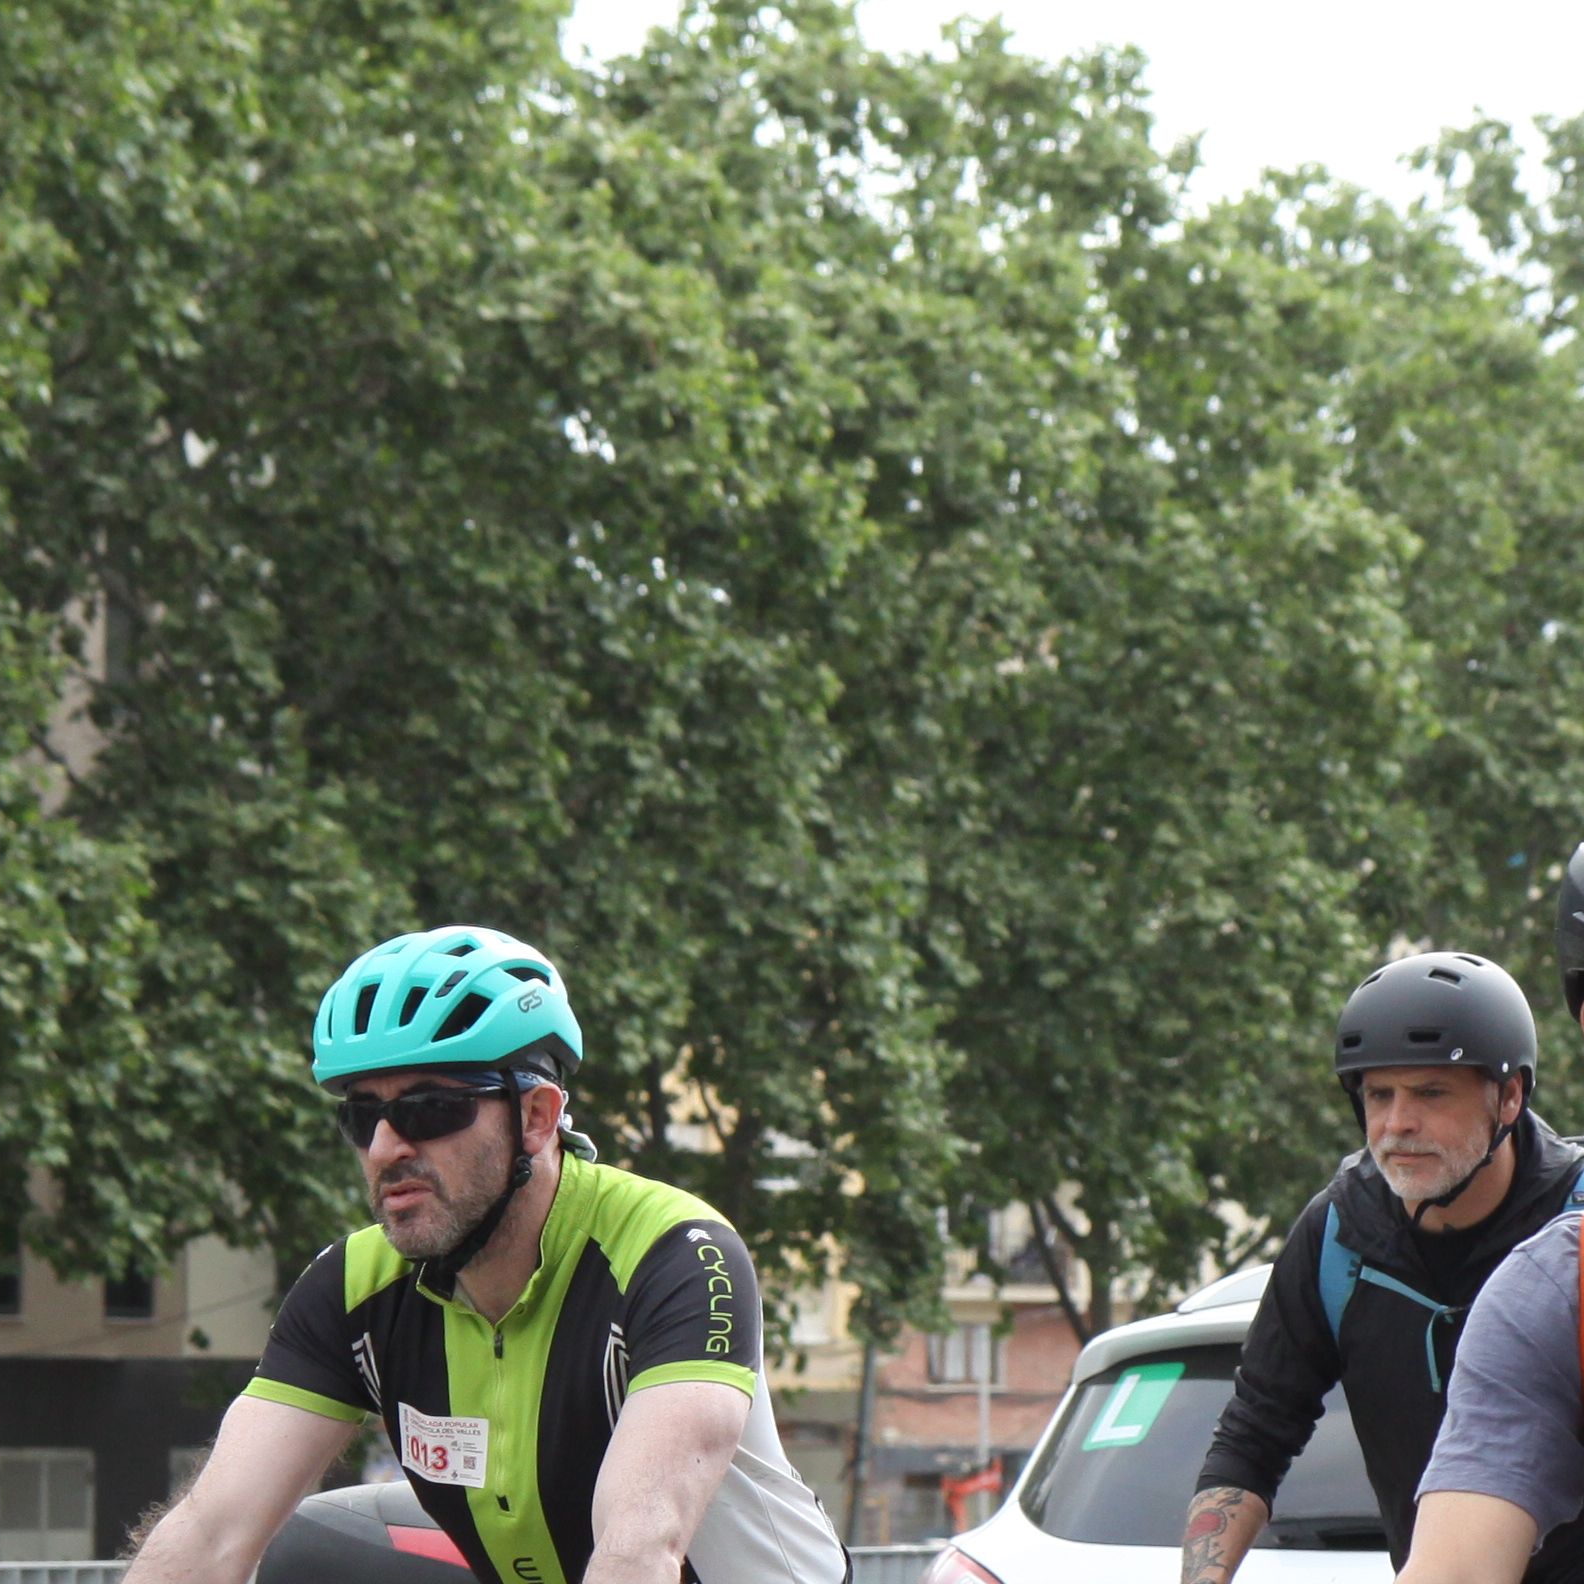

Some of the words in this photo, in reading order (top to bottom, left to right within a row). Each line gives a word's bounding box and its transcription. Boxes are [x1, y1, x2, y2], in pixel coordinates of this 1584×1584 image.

[697, 1244, 733, 1354] CYCLING
[1091, 1373, 1143, 1442] L
[410, 1434, 449, 1471] 013
